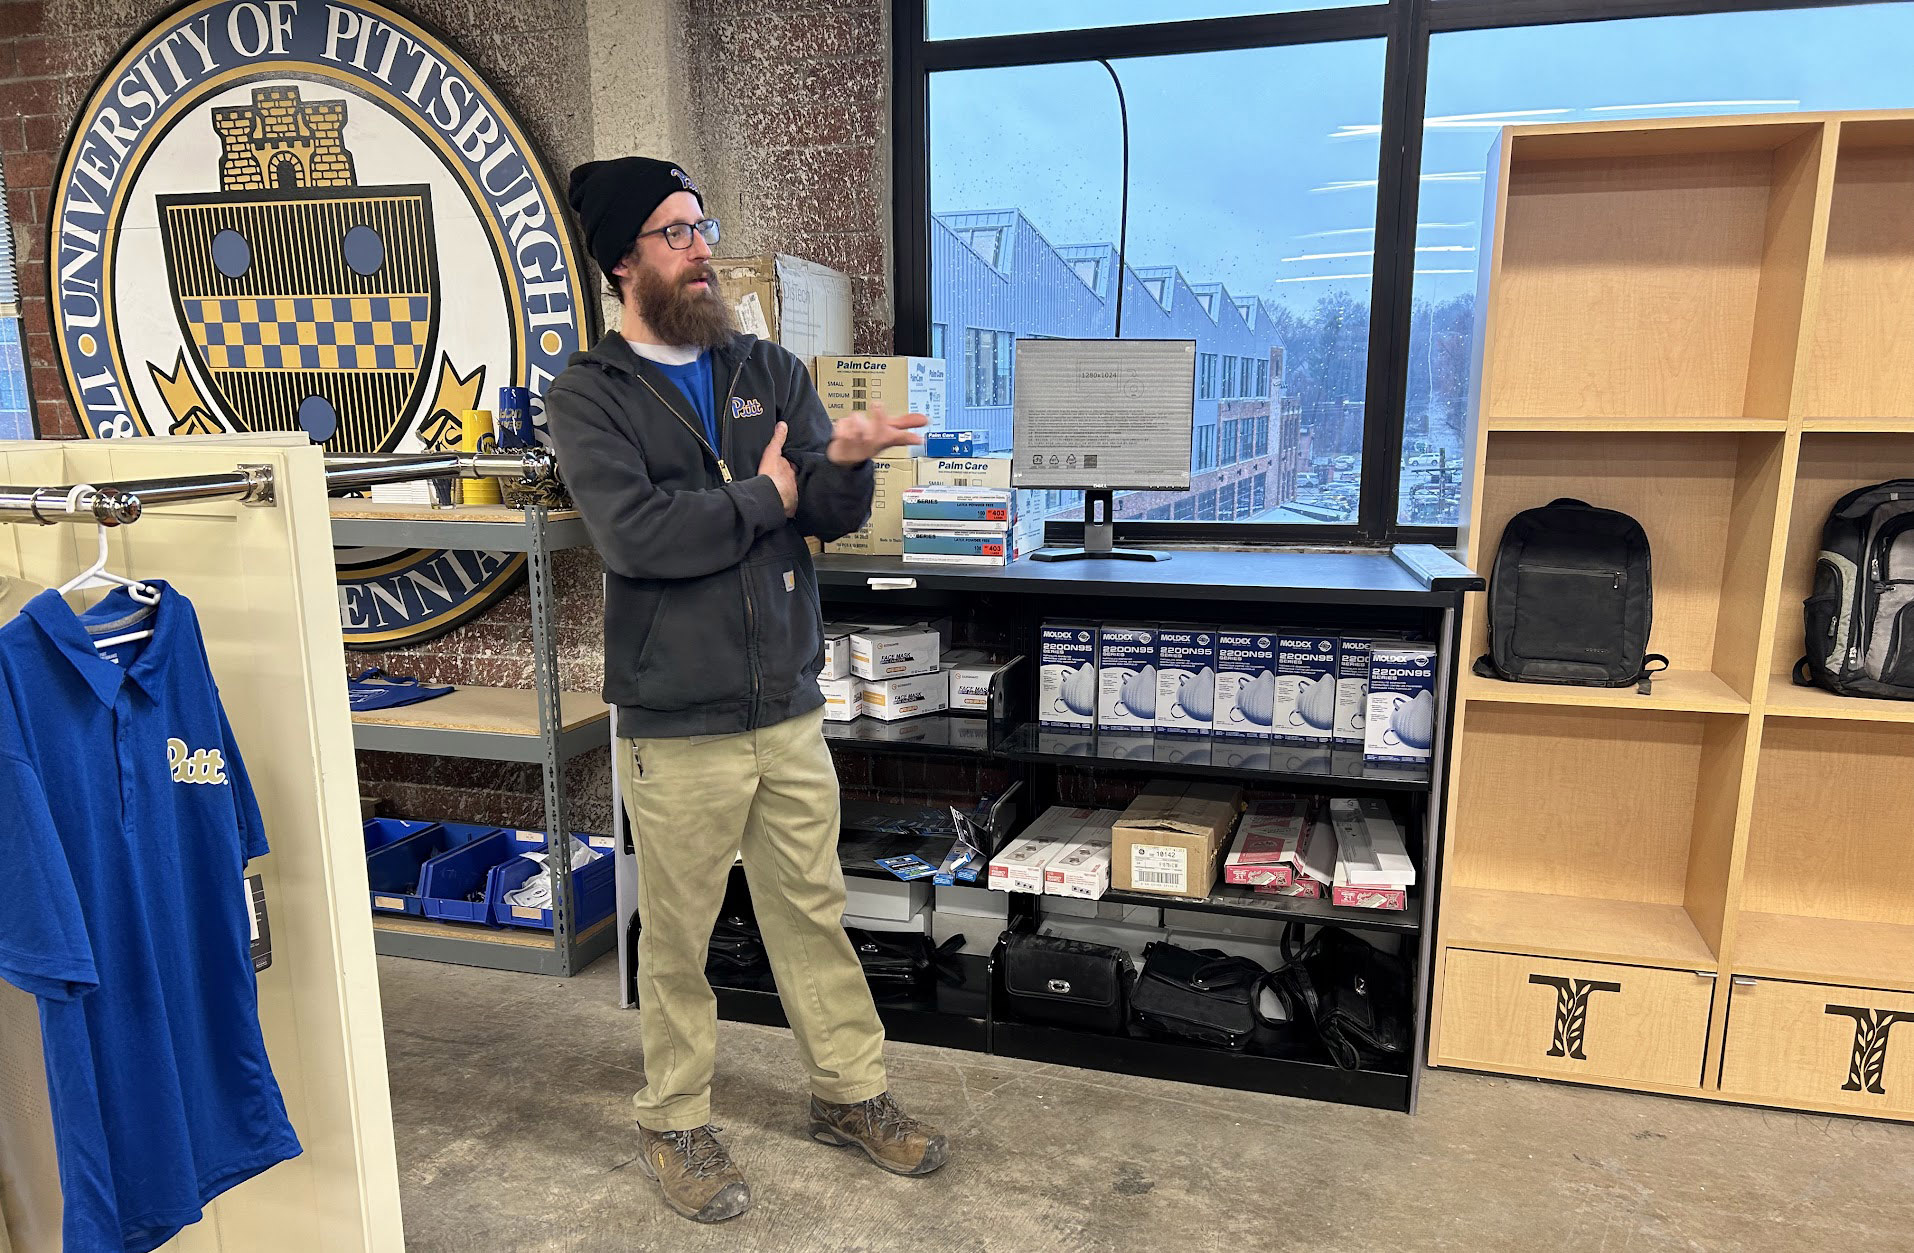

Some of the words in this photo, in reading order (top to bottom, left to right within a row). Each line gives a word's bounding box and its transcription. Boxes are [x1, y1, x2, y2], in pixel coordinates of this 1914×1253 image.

[61, 15, 219, 330] UNIVERSITY
[228, 0, 299, 58] OF
[321, 3, 574, 331] PITTSBURGH
[837, 361, 862, 370] Palm
[864, 361, 887, 370] Care
[77, 366, 134, 439] 178
[732, 397, 763, 419] Pitt
[939, 461, 963, 470] Palm
[964, 462, 988, 470] Care
[337, 548, 511, 629] ENNIA
[1043, 643, 1092, 651] 2200N95
[1280, 640, 1312, 648] MOLDEX
[1160, 647, 1212, 655] 2200N95
[1219, 650, 1272, 658] 2200N95
[1279, 653, 1333, 662] 2200N95
[1372, 655, 1407, 663] MOLDEX
[1372, 668, 1431, 677] 2200N95
[167, 738, 226, 785] Pitt
